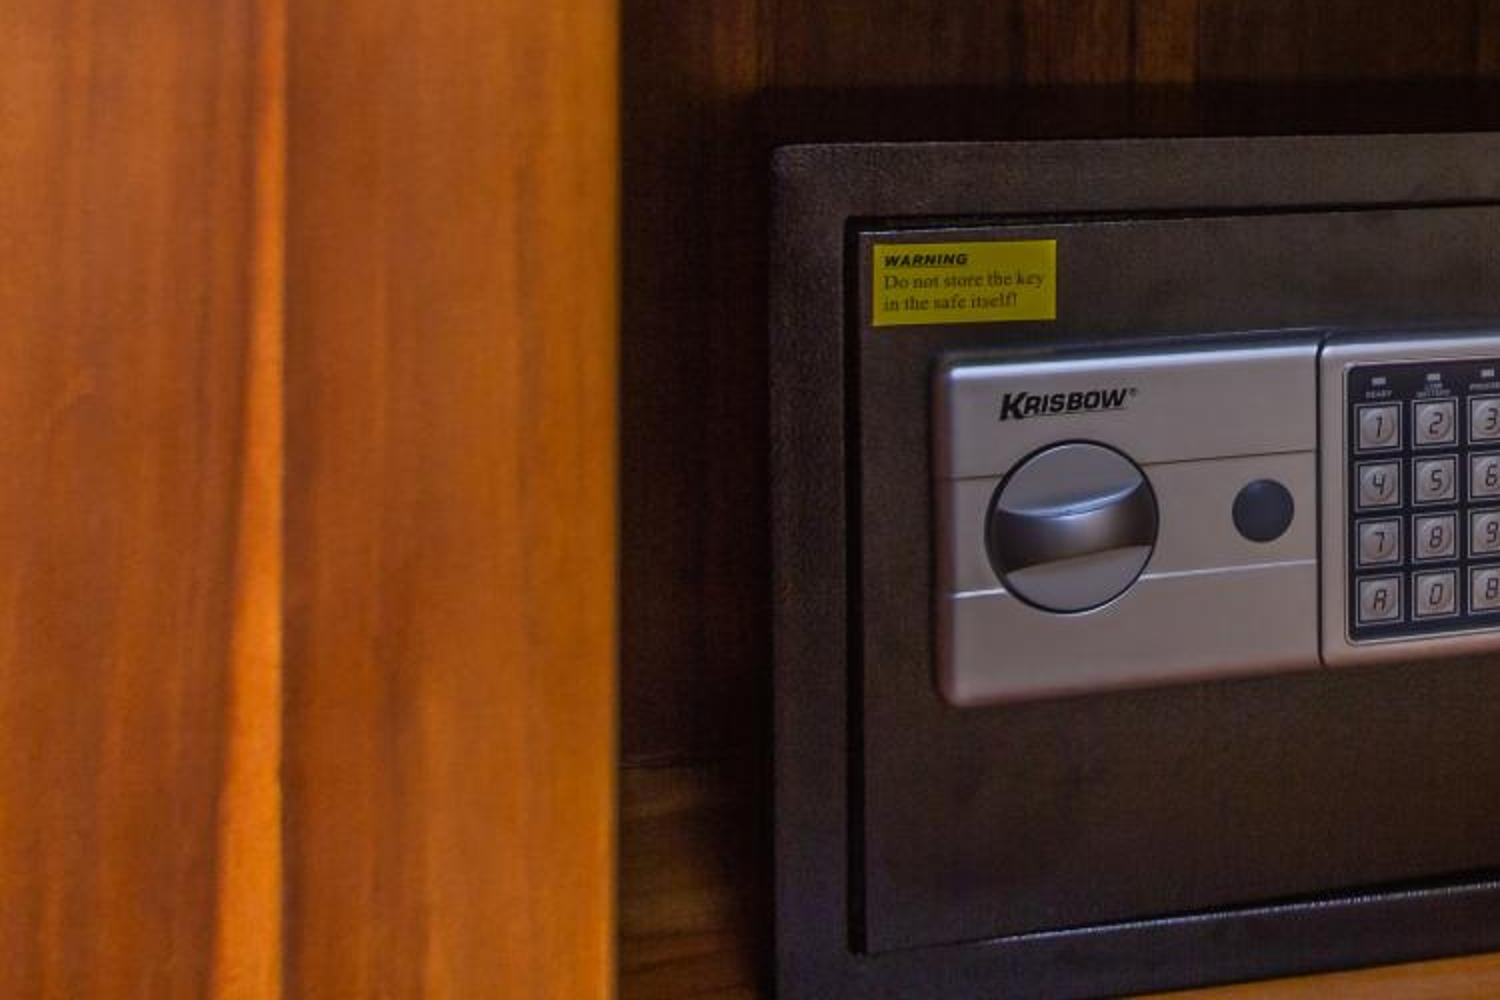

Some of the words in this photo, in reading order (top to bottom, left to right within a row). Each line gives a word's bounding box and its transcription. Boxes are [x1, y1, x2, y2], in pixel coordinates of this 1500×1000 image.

[884, 253, 969, 267] WARNING
[884, 275, 909, 290] Do
[912, 274, 939, 289] not
[943, 272, 984, 289] store
[987, 270, 1013, 286] the
[1016, 269, 1045, 289] key
[883, 296, 899, 312] in
[903, 295, 928, 311] the
[933, 293, 967, 309] safe
[1428, 411, 1444, 435] 2
[1484, 407, 1499, 430] 3
[1372, 472, 1386, 496] 4
[1430, 469, 1444, 492] 5
[1484, 464, 1499, 488] 6
[1373, 531, 1386, 553] 7
[1428, 525, 1444, 549] 8
[1486, 521, 1500, 543] 9
[1373, 588, 1388, 612] A
